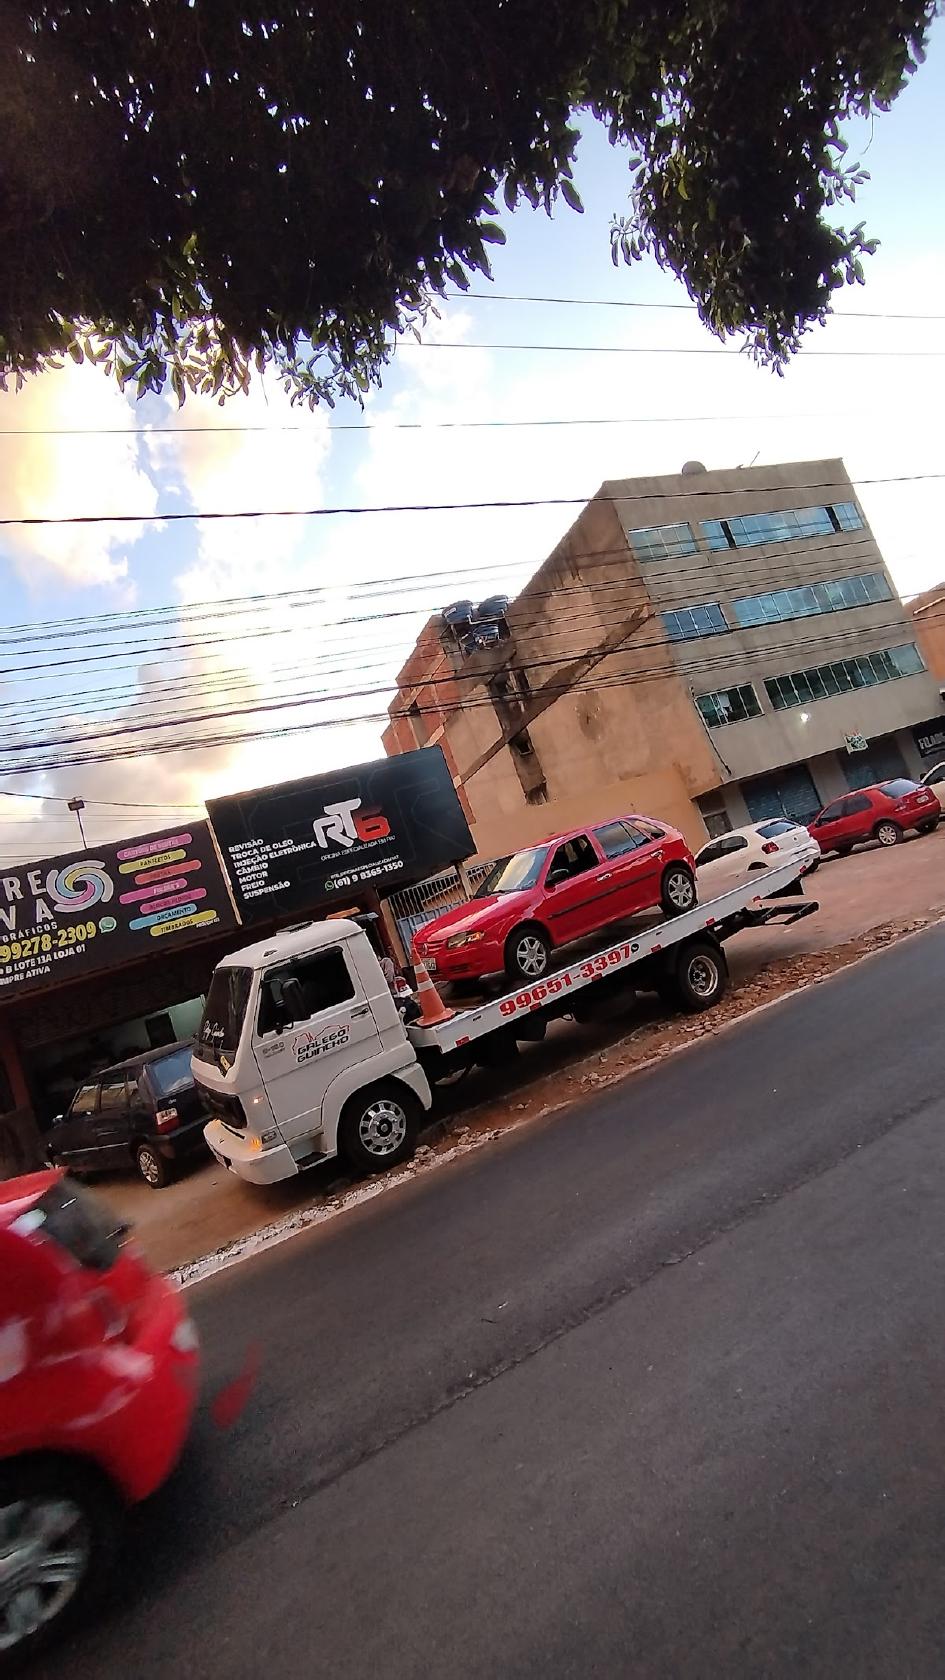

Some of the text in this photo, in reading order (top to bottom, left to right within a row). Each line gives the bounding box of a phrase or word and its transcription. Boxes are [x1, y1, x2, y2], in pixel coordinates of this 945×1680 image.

[228, 839, 264, 853] REVISÃO
[231, 848, 260, 861] TROCA
[260, 844, 272, 853] DE
[233, 841, 317, 869] INJEÇÃO ELETRÔNICA
[236, 862, 269, 876] CÂMBIO
[238, 870, 269, 884] MOTOR
[240, 879, 265, 892] FREIO
[243, 880, 291, 900] SUSPENSÃO
[333, 876, 351, 889] (61)
[13, 958, 36, 971] LOTE
[37, 954, 53, 965] 13A
[53, 947, 76, 960] LOJA
[25, 965, 51, 979] ATIVA
[500, 943, 630, 1017] 99651-3397
[297, 1029, 346, 1055] GALEGO
[297, 1035, 349, 1063] GUINCHO
